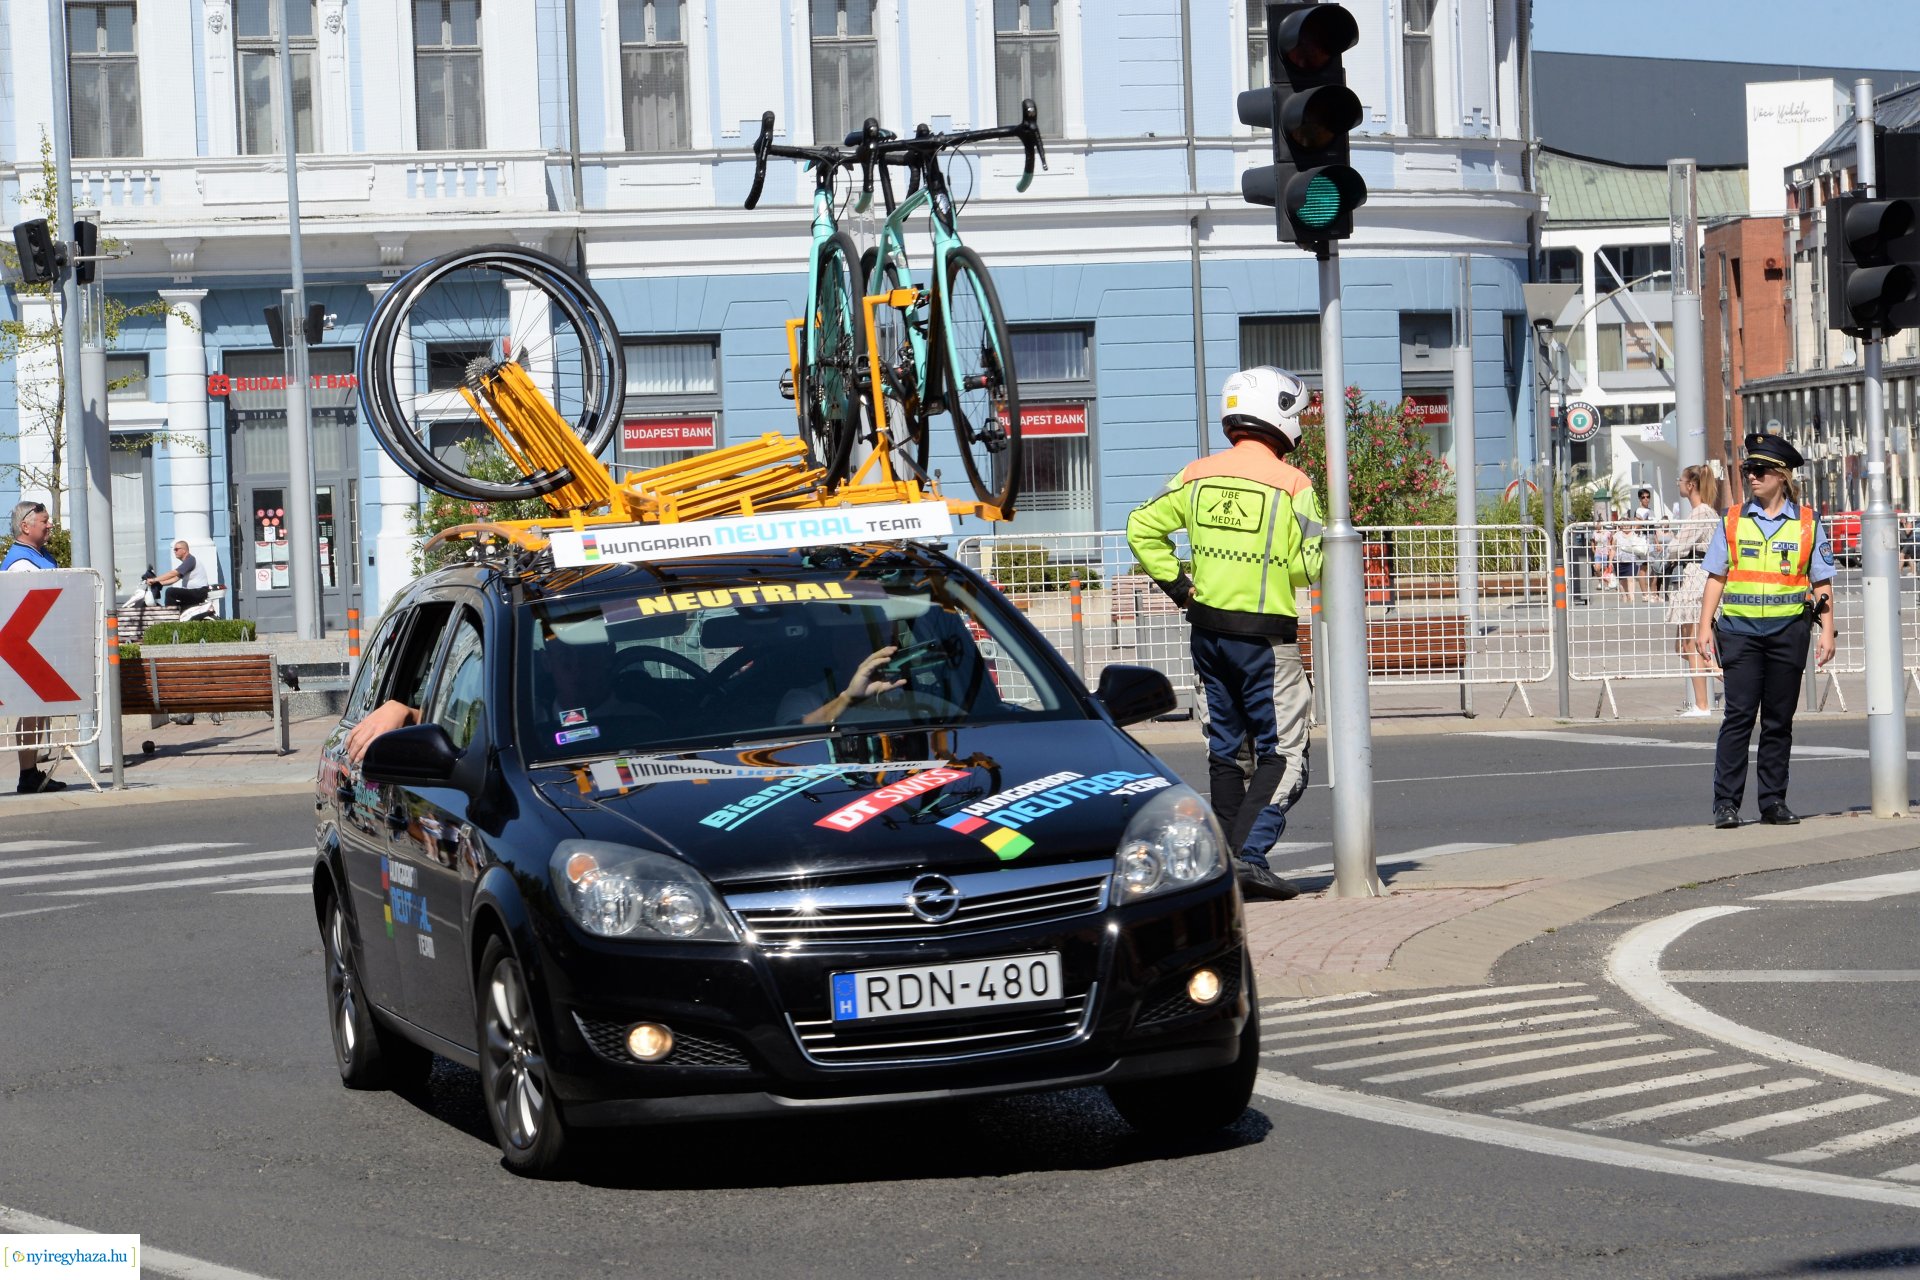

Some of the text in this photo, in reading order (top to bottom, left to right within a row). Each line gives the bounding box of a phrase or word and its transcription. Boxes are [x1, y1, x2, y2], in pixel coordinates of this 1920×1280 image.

[237, 374, 359, 391] BUDAT BAN
[1430, 404, 1449, 415] BANK
[998, 414, 1084, 426] BUAPEST BANK
[624, 427, 712, 439] BUDAPEST BANK
[1221, 490, 1240, 500] UBE
[1211, 514, 1242, 526] MEDIA
[600, 516, 922, 555] HUNGARIAN NEUTRAL TEAM
[636, 582, 854, 616] NEUTRAL
[1766, 592, 1804, 604] POLICE
[699, 763, 842, 828] Bianchi
[825, 768, 961, 830] DT SWISS
[960, 770, 1085, 817] HUNGARIAN
[985, 770, 1155, 830] NEUTRAL
[866, 960, 1048, 1013] RDN-480
[840, 1000, 853, 1014] H
